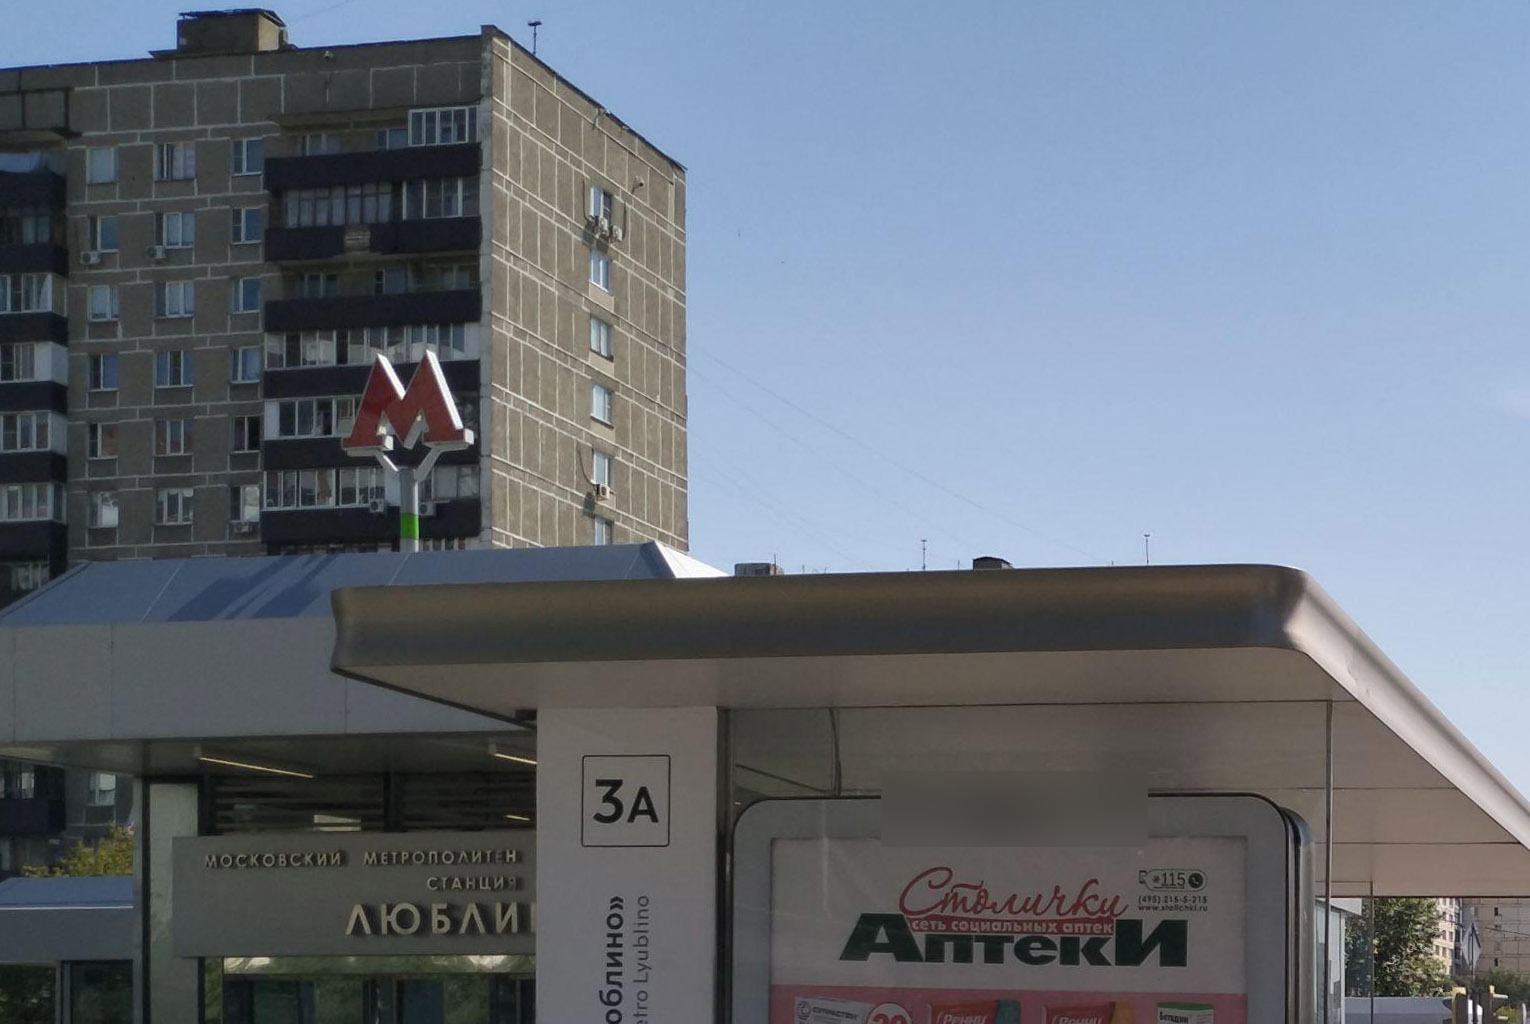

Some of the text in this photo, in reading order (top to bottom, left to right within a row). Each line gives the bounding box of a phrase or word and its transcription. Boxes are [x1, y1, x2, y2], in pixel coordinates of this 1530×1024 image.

[204, 849, 517, 869] МОСКОВСКИЙ МЕТРОПОЛИТЕН
[426, 875, 518, 892] СТАНЦИЯ
[900, 866, 1129, 918] Столички
[345, 902, 537, 936] ЛЮБЛИ
[911, 918, 1113, 935] сеть социальных аптек
[631, 894, 653, 985] Lyublino
